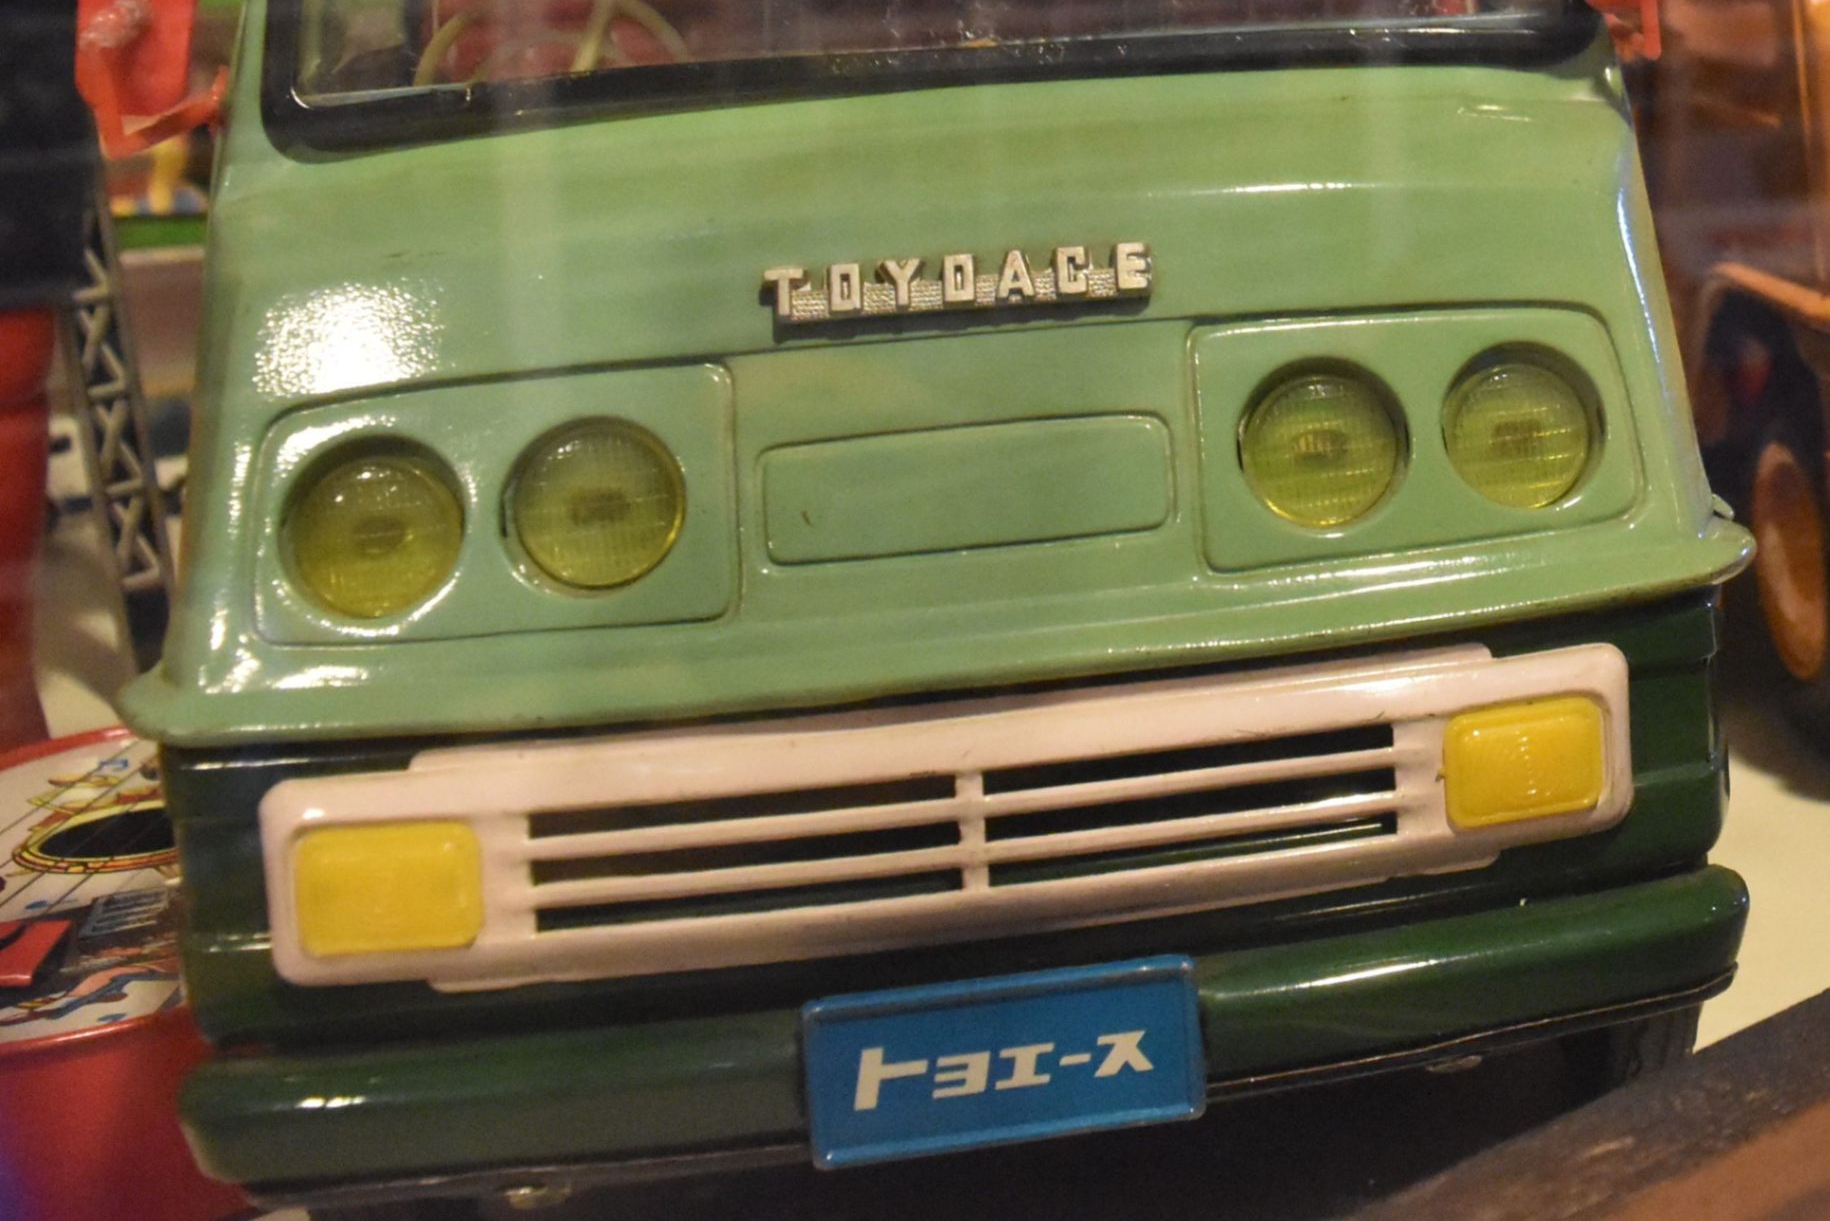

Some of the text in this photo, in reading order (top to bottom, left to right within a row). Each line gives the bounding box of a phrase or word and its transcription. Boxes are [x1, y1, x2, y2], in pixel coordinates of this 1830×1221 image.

[763, 241, 1152, 319] TOYOACE
[853, 1030, 1154, 1112] トヨエース
